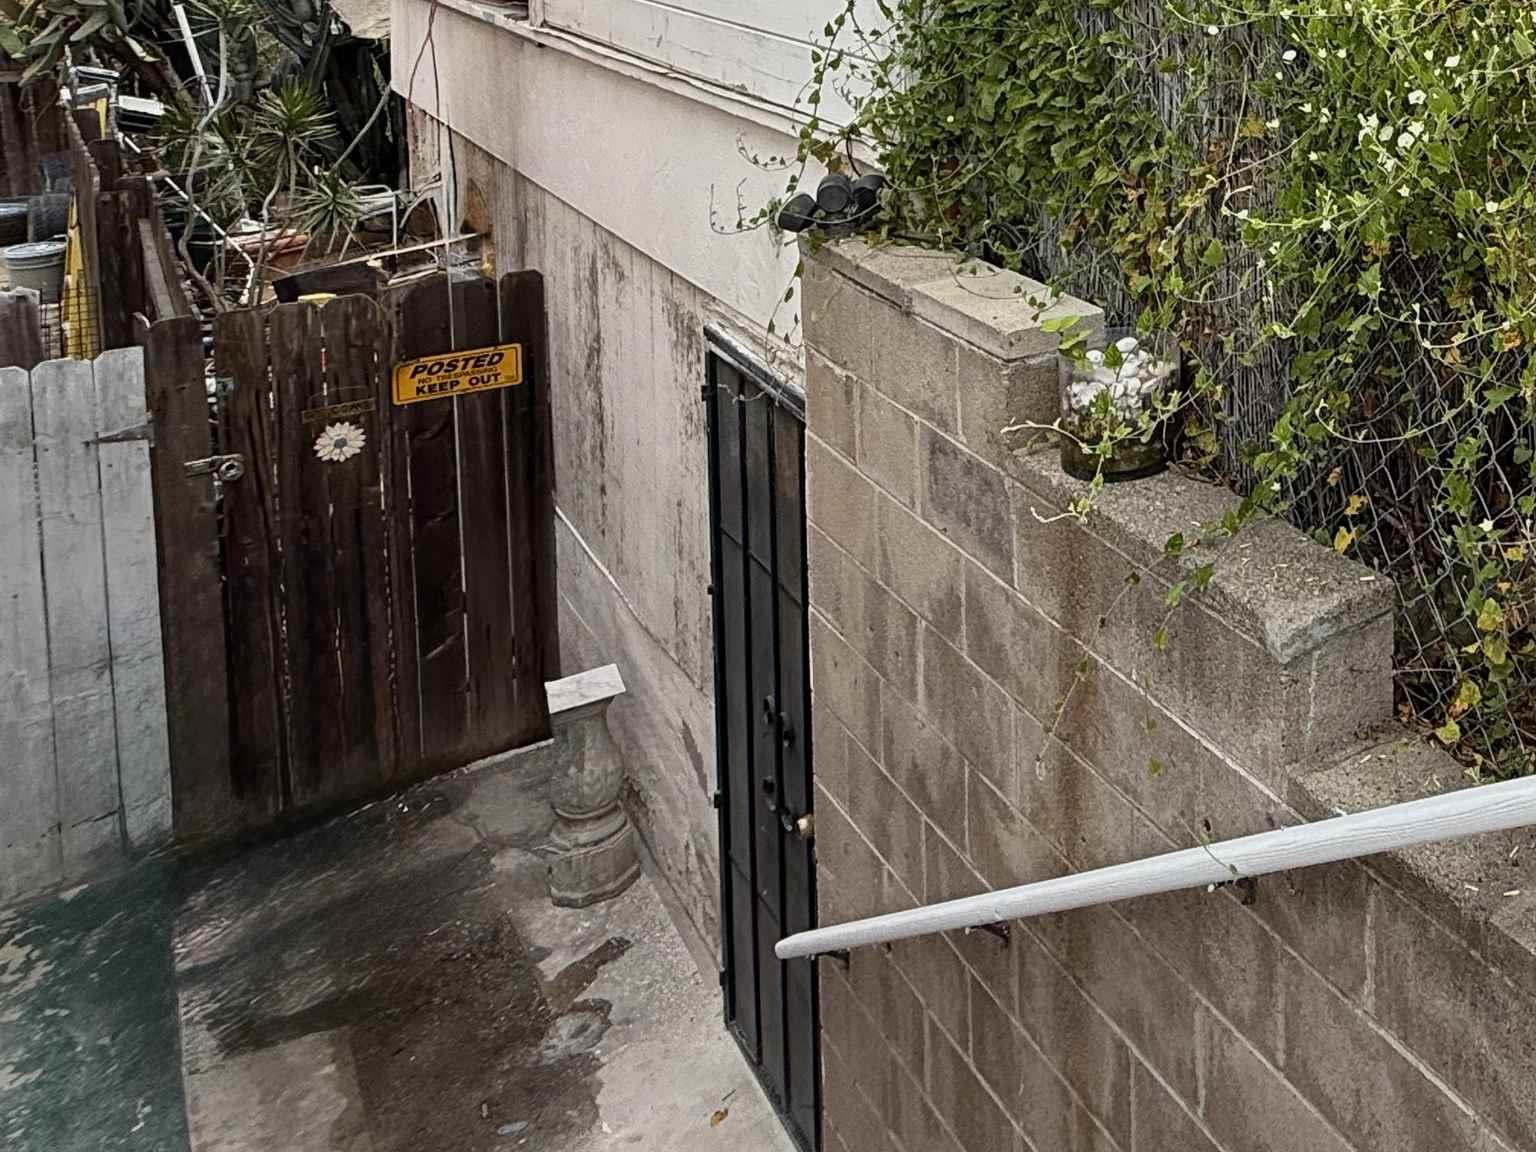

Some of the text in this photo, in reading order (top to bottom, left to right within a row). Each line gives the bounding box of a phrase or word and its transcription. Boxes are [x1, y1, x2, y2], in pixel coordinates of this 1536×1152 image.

[409, 352, 505, 379] POSTED
[416, 372, 501, 396] KEEP OUT
[418, 376, 432, 385] NO
